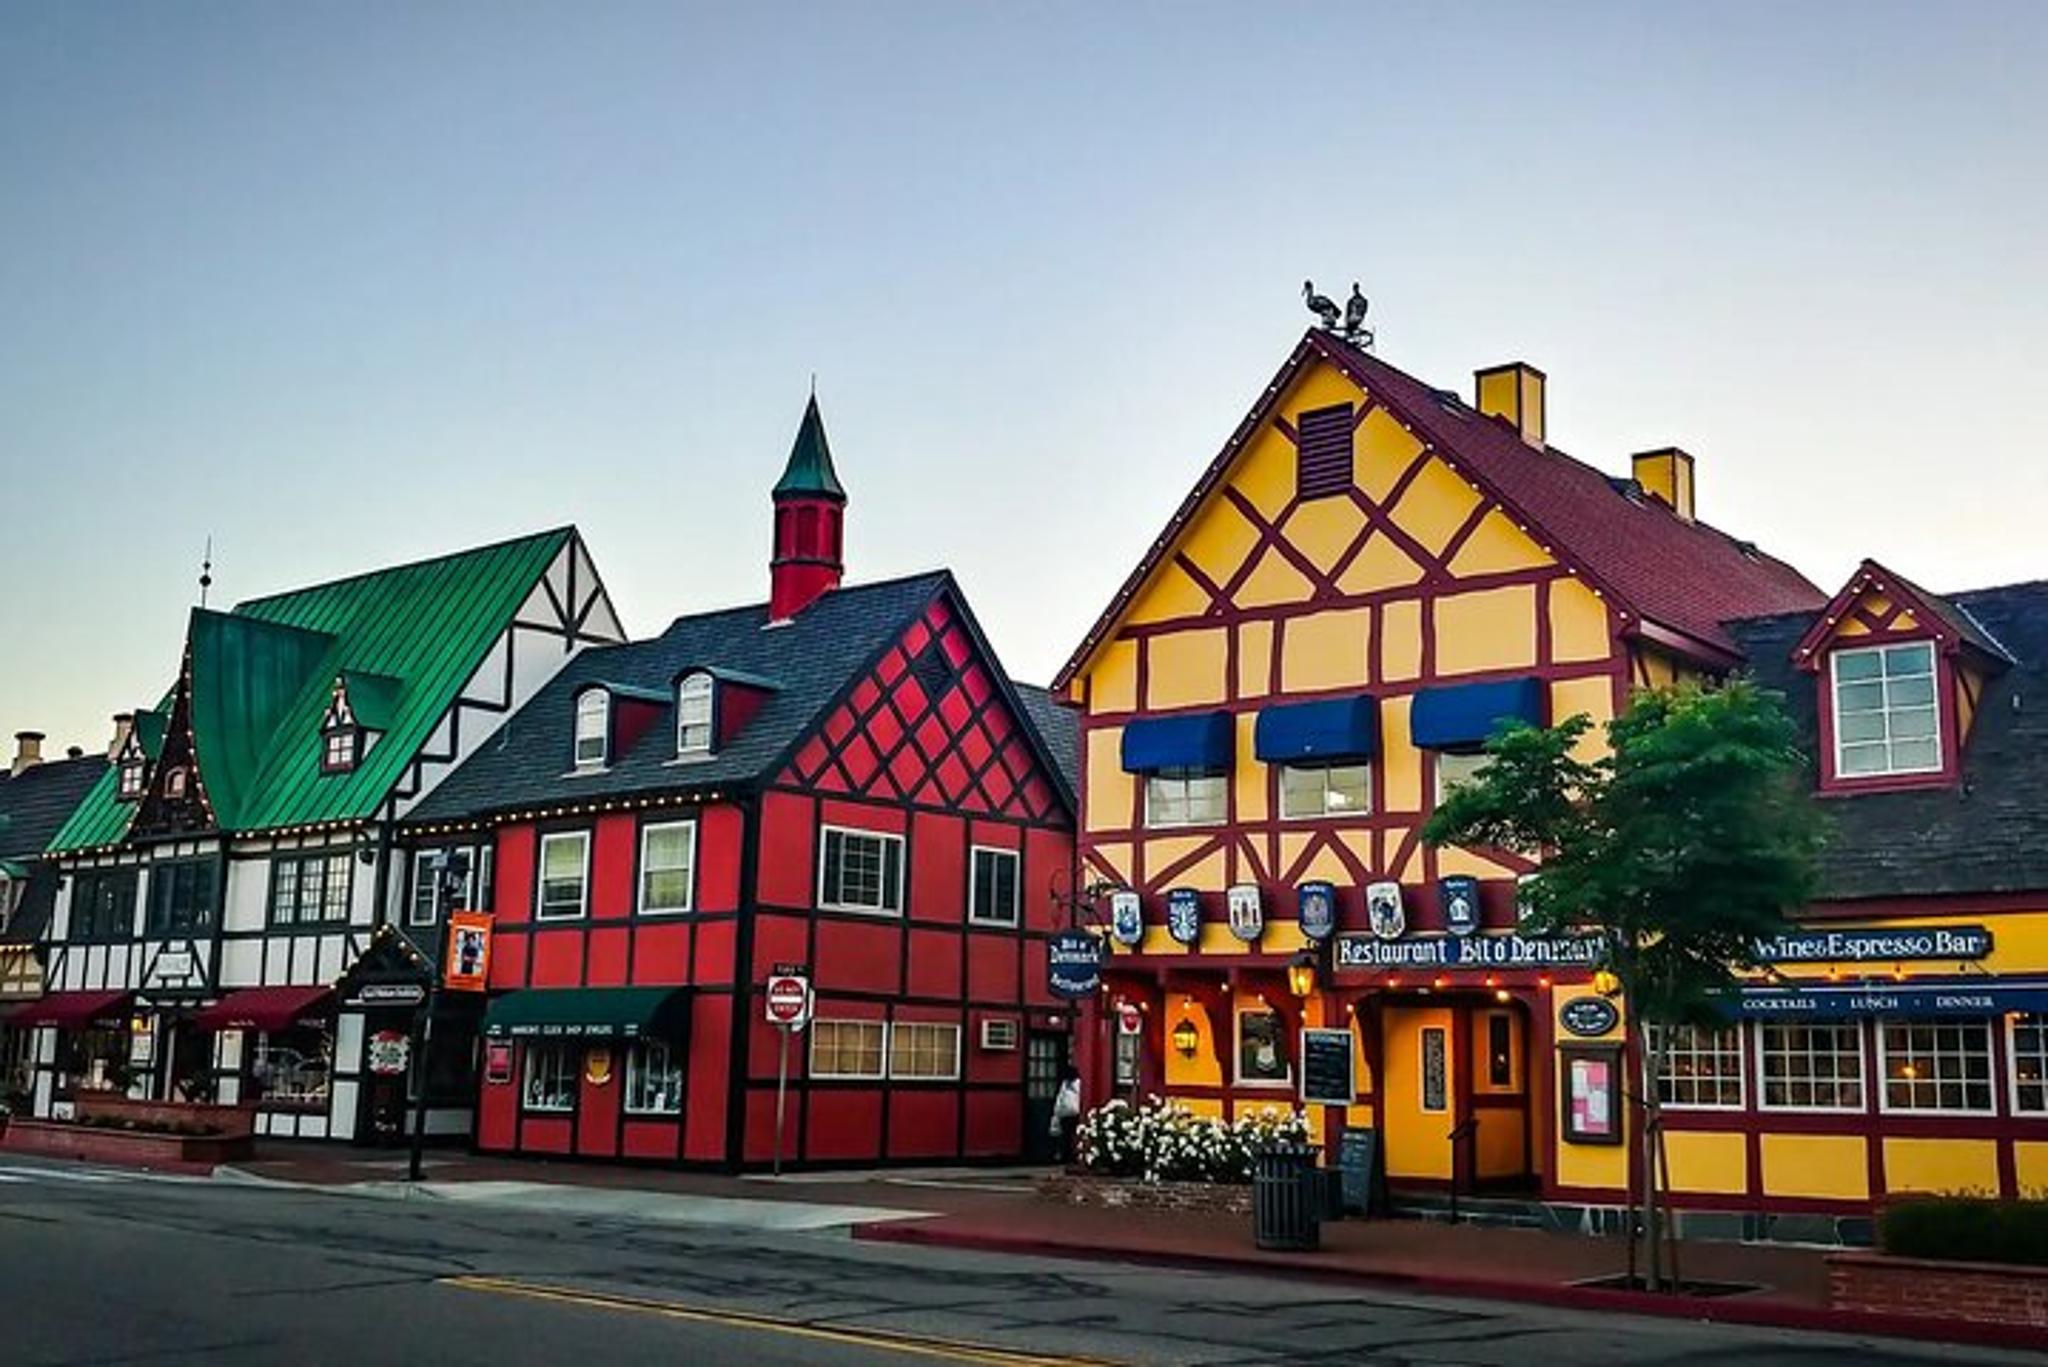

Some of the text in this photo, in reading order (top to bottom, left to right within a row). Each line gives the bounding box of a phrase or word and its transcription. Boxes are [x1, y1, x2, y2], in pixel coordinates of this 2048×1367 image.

[1338, 938, 1447, 964] Restaurant
[1459, 936, 1490, 963] Bit
[1935, 930, 1976, 954] Bar
[1050, 945, 1099, 963] Denmark
[1742, 996, 1994, 1010] COCKTAILS LUNCH DINNER
